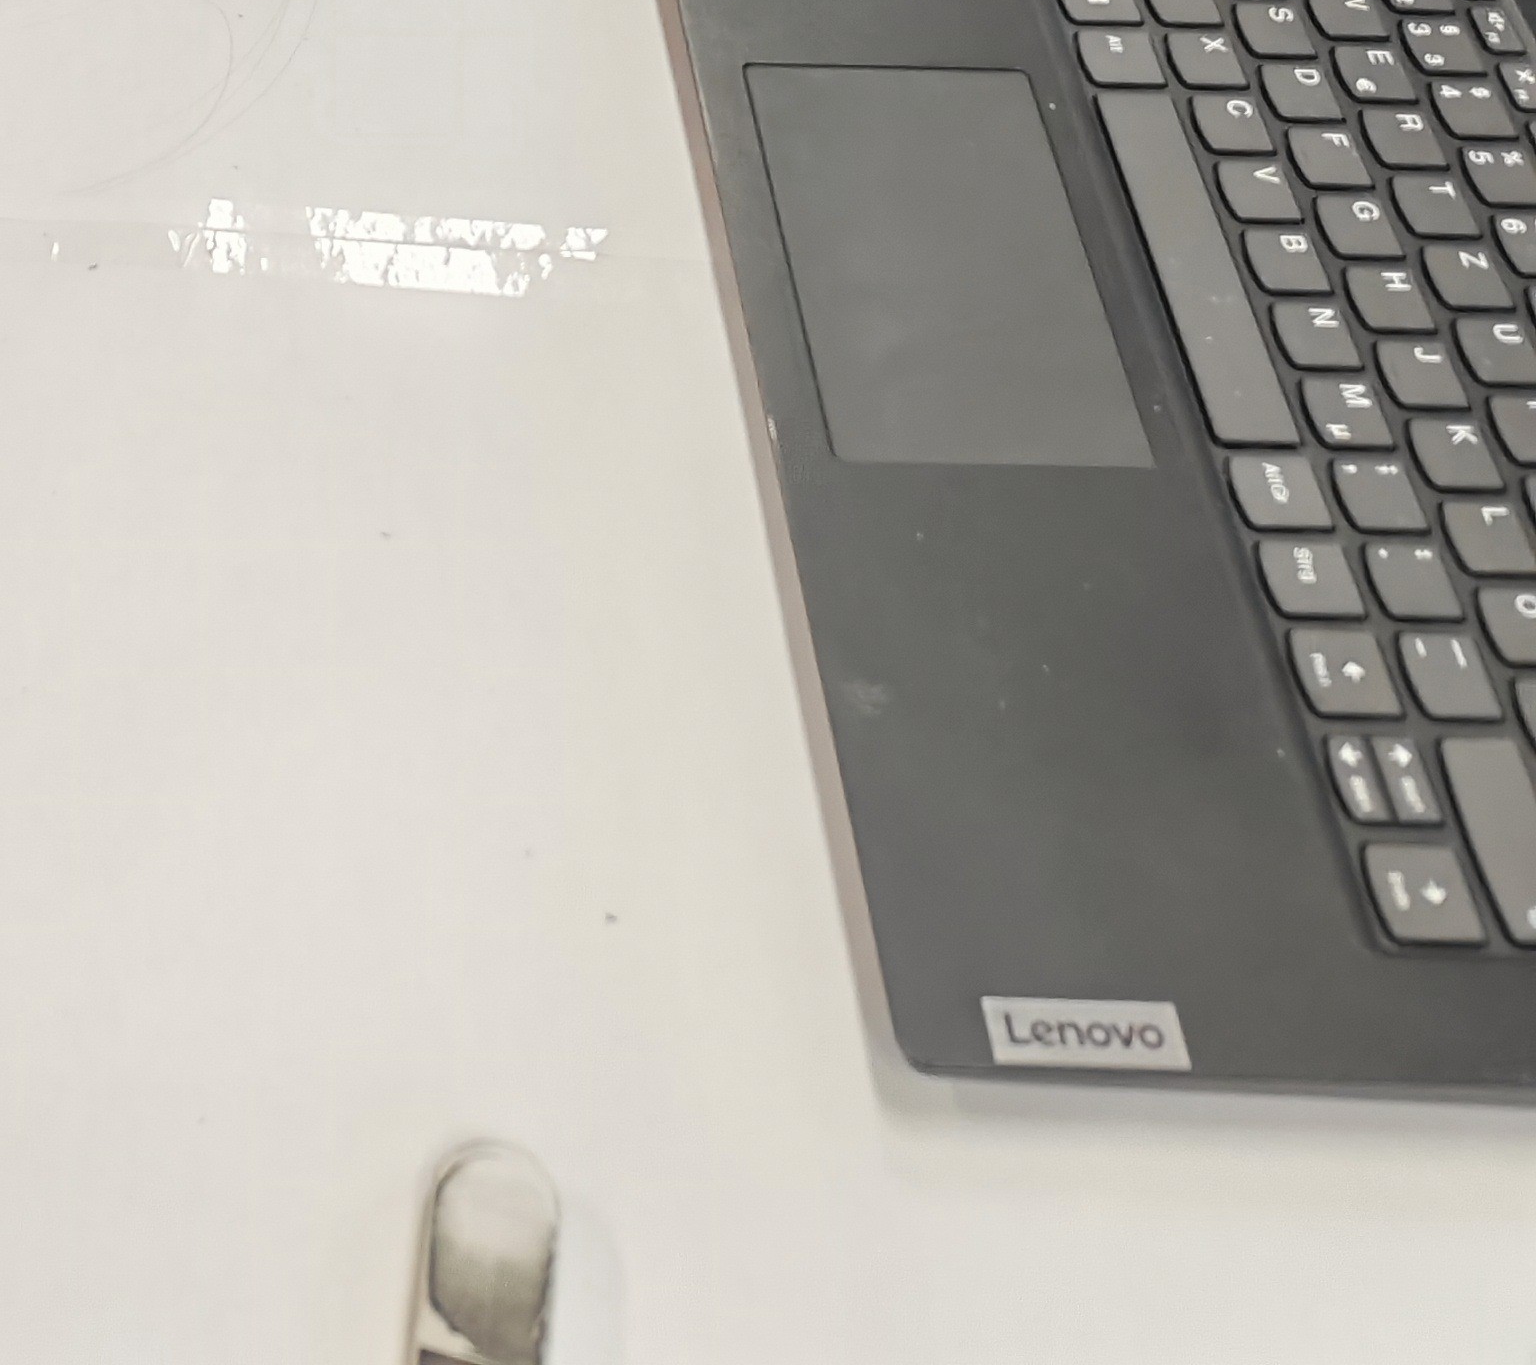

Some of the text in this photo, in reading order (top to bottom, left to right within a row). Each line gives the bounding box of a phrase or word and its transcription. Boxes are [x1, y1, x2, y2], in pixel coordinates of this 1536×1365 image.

[1268, 5, 1294, 22] S
[1407, 21, 1432, 37] 3
[1200, 36, 1228, 52] X
[1365, 48, 1394, 65] E
[1292, 65, 1323, 86] D
[1439, 85, 1462, 98] 4
[1227, 100, 1258, 118] C
[1395, 114, 1426, 131] R
[1322, 133, 1350, 147] F
[1468, 150, 1495, 165] 5
[1253, 165, 1280, 184] V
[1429, 181, 1456, 199] T
[1352, 201, 1380, 221] G
[1501, 218, 1527, 234] 6
[1280, 233, 1308, 253] B
[1458, 251, 1489, 269] Z
[1381, 272, 1412, 291] H
[1308, 308, 1339, 328] N
[1493, 323, 1523, 344] U
[1414, 347, 1443, 363] J
[1339, 384, 1372, 408] M
[1446, 425, 1478, 445] K
[1481, 506, 1509, 525] L
[1004, 1011, 1164, 1051] Lenovo
